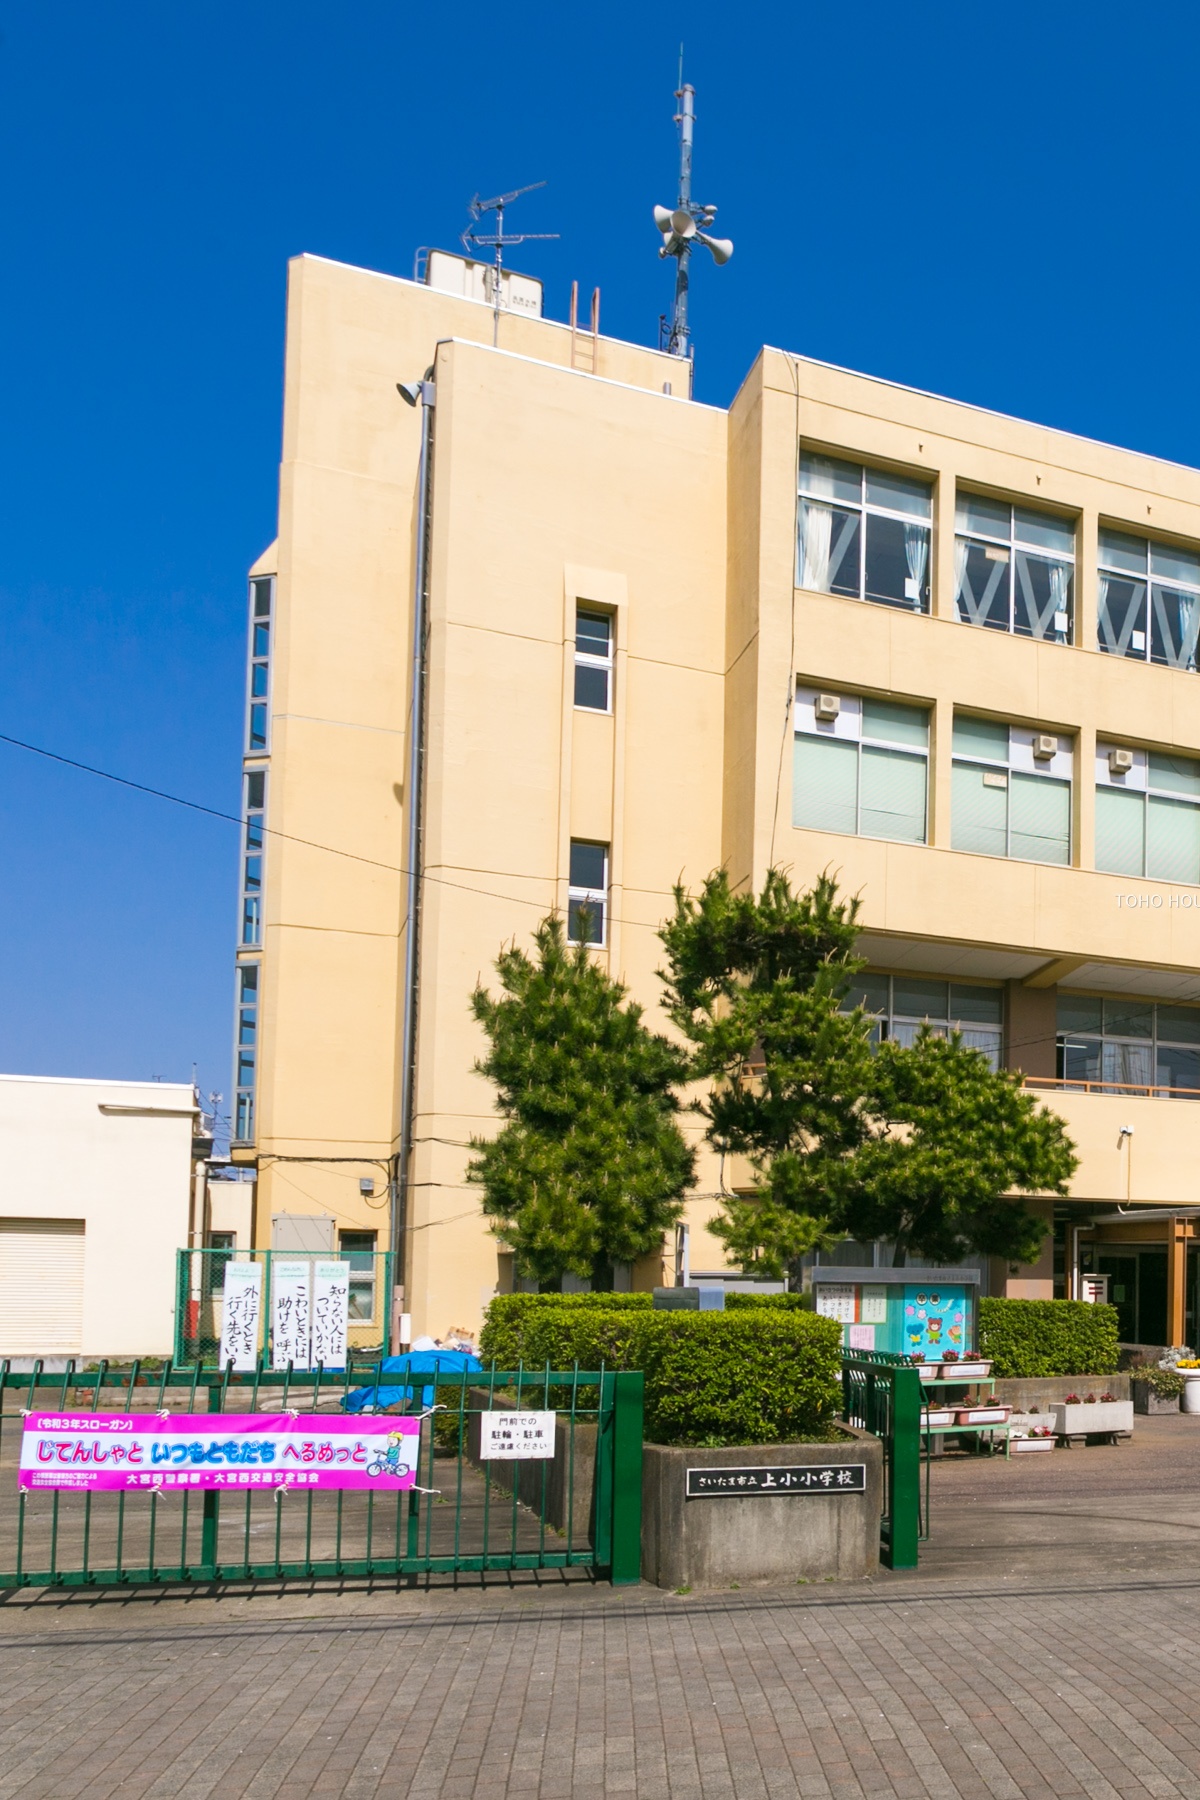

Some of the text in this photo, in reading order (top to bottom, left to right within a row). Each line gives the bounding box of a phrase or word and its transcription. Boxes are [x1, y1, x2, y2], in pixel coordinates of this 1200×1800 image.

[241, 1285, 259, 1354] 外に行くとき
[295, 1286, 308, 1359] こわいときには
[315, 1297, 329, 1363] ついていかない
[329, 1285, 347, 1354] 知らない人には
[491, 1430, 544, 1439] 駐輪・駐車
[498, 1417, 537, 1426] 門前での
[36, 1439, 369, 1464] じてんしゃと いつもともだち へるめっと
[698, 1469, 855, 1488] さいたま市立上小小学校
